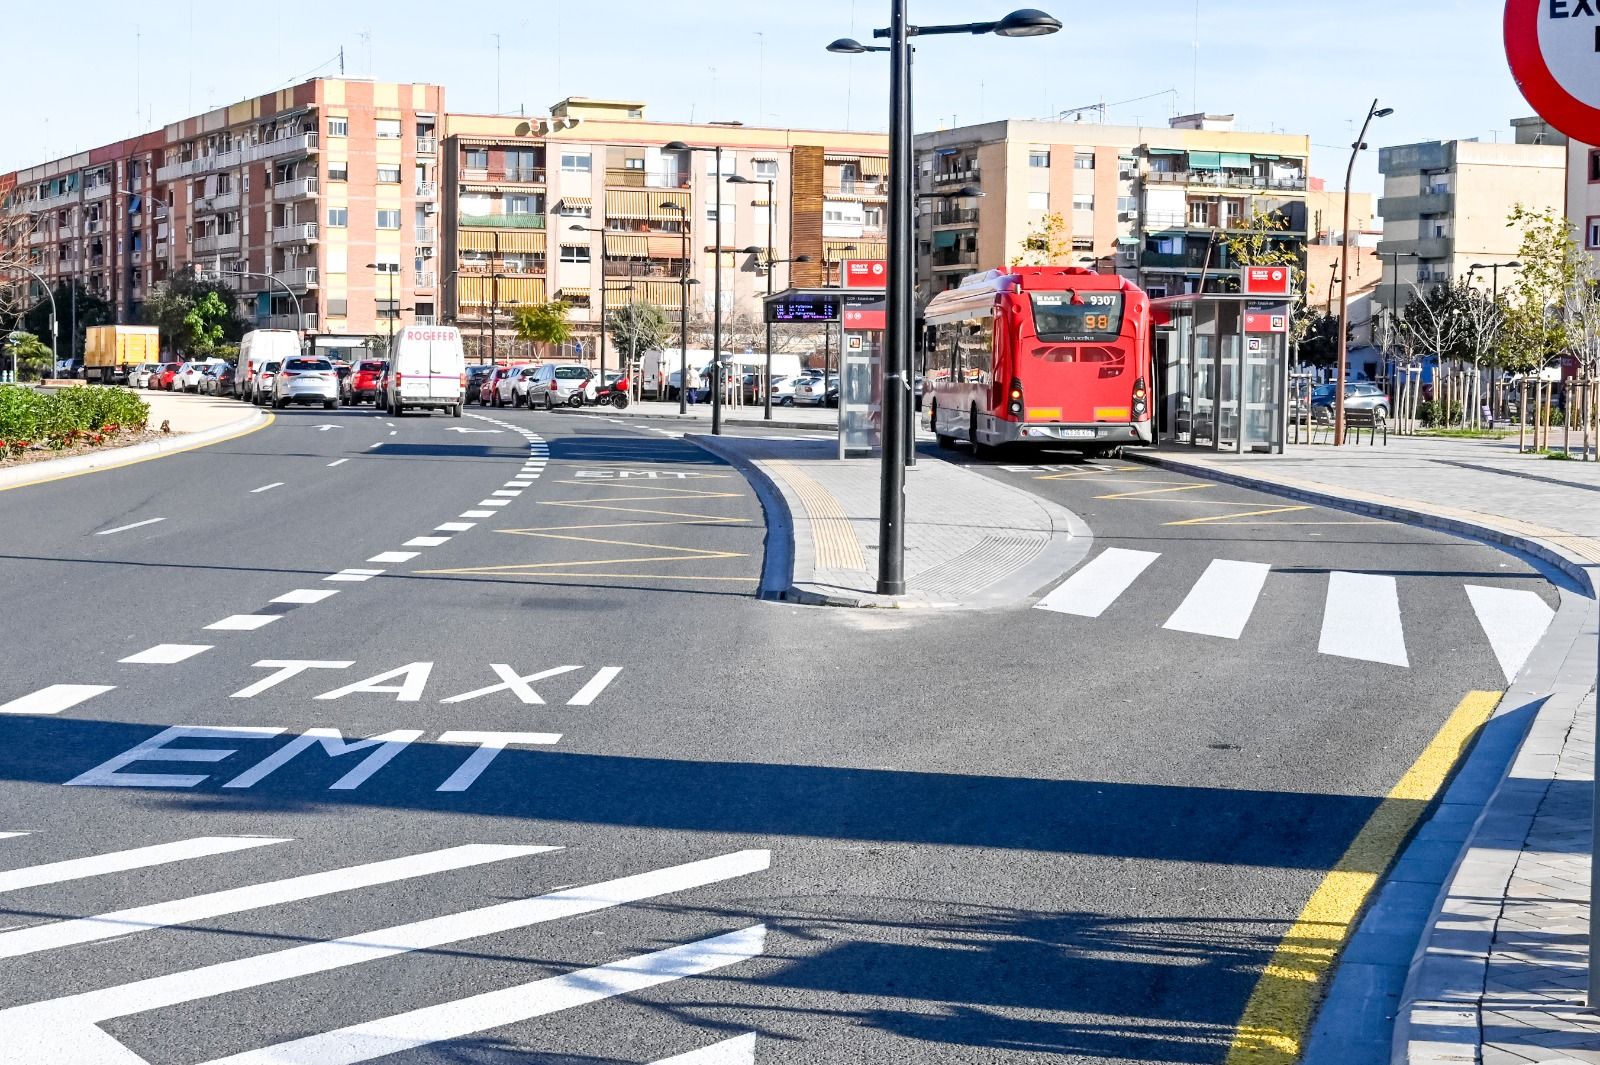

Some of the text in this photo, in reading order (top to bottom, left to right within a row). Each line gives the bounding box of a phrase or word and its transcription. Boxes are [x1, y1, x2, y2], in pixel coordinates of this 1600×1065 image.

[1550, 0, 1600, 18] EX
[1090, 296, 1117, 305] 9307
[1086, 315, 1108, 329] 98
[407, 331, 454, 341] ROGEFER
[574, 470, 700, 479] EMT
[229, 659, 623, 705] TAXI
[62, 725, 563, 792] EMT
